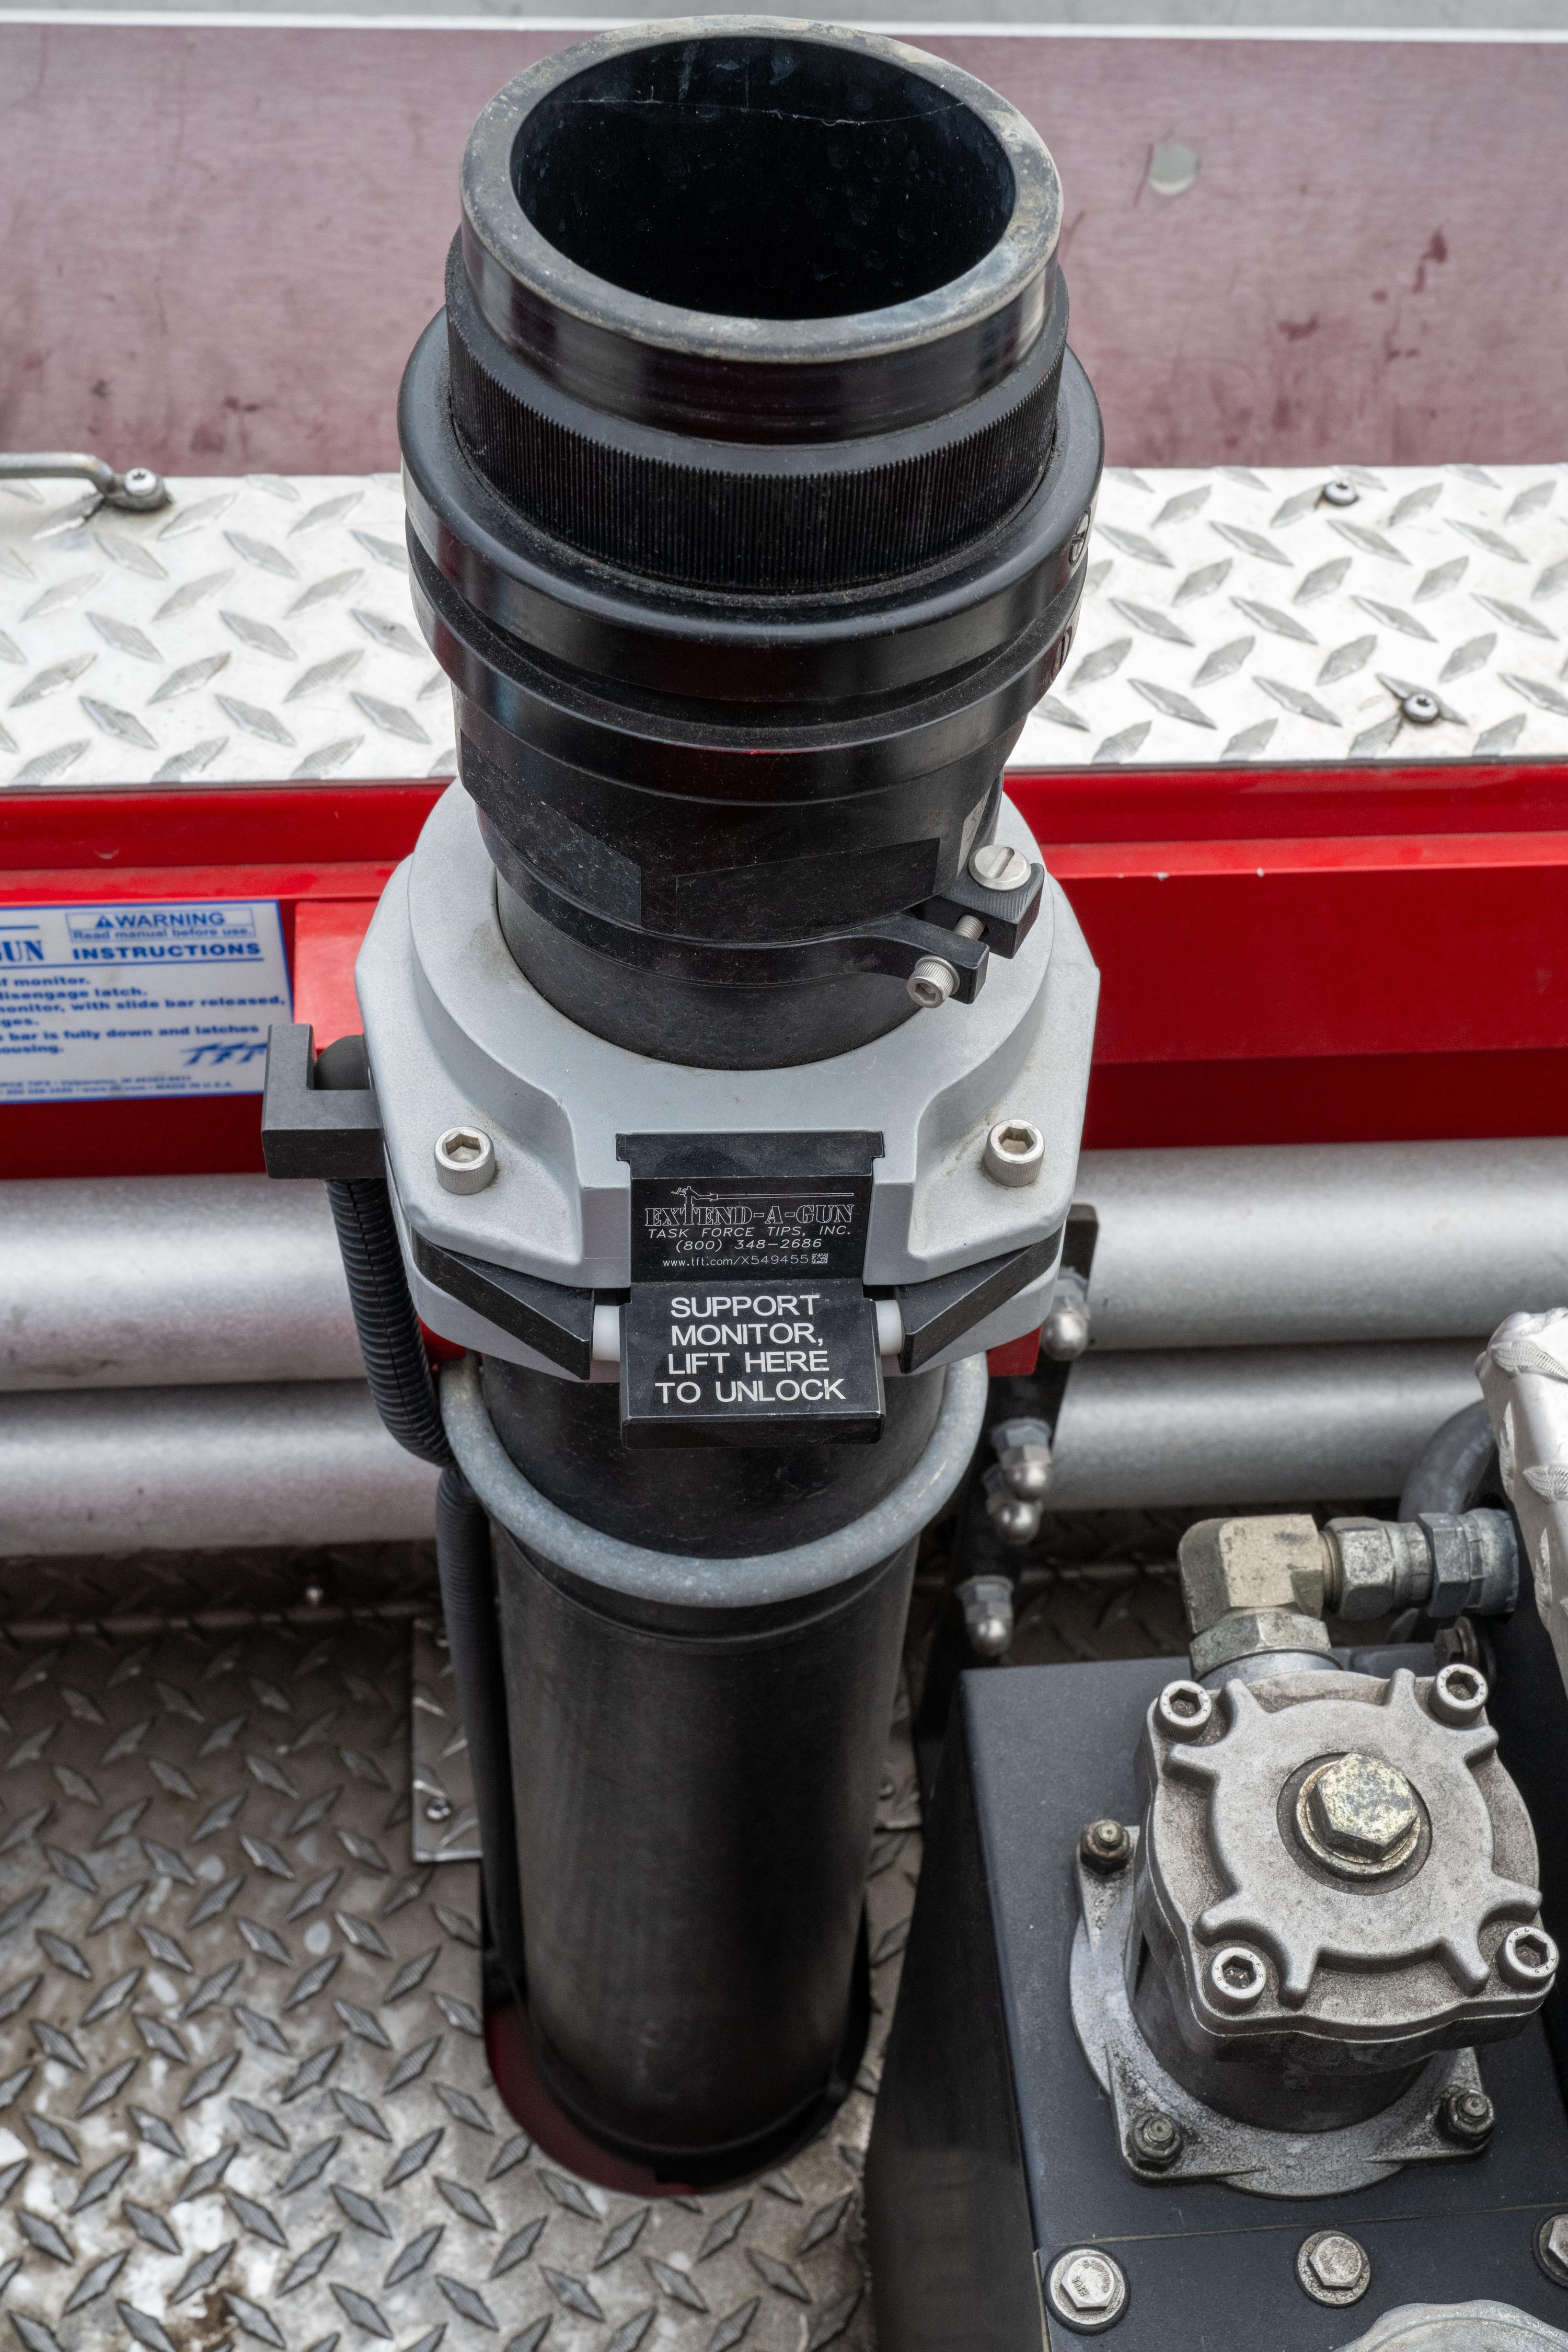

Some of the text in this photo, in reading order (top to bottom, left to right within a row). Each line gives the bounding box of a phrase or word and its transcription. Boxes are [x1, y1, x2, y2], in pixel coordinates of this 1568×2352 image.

[116, 912, 225, 928] WARNING
[73, 929, 110, 940] Read
[116, 928, 167, 939] manual
[172, 927, 217, 938] before
[0, 940, 44, 961] UN
[73, 942, 261, 960] INSTRUCTIONS
[72, 1001, 110, 1010] with
[165, 998, 194, 1008] bar
[0, 1045, 64, 1055] ousing.
[645, 1204, 854, 1227] EXTEND-A-GUN
[648, 1225, 852, 1239] TASK FORCE TIPS, INC.
[676, 1238, 823, 1253] (800) 348-2686
[663, 1254, 809, 1267] www.tft.com/X549455
[671, 1294, 821, 1318] SUPPORT
[671, 1322, 823, 1346] MONITOR,
[668, 1350, 829, 1375] LIFT HERE
[654, 1378, 846, 1404] TO UNLOCK
